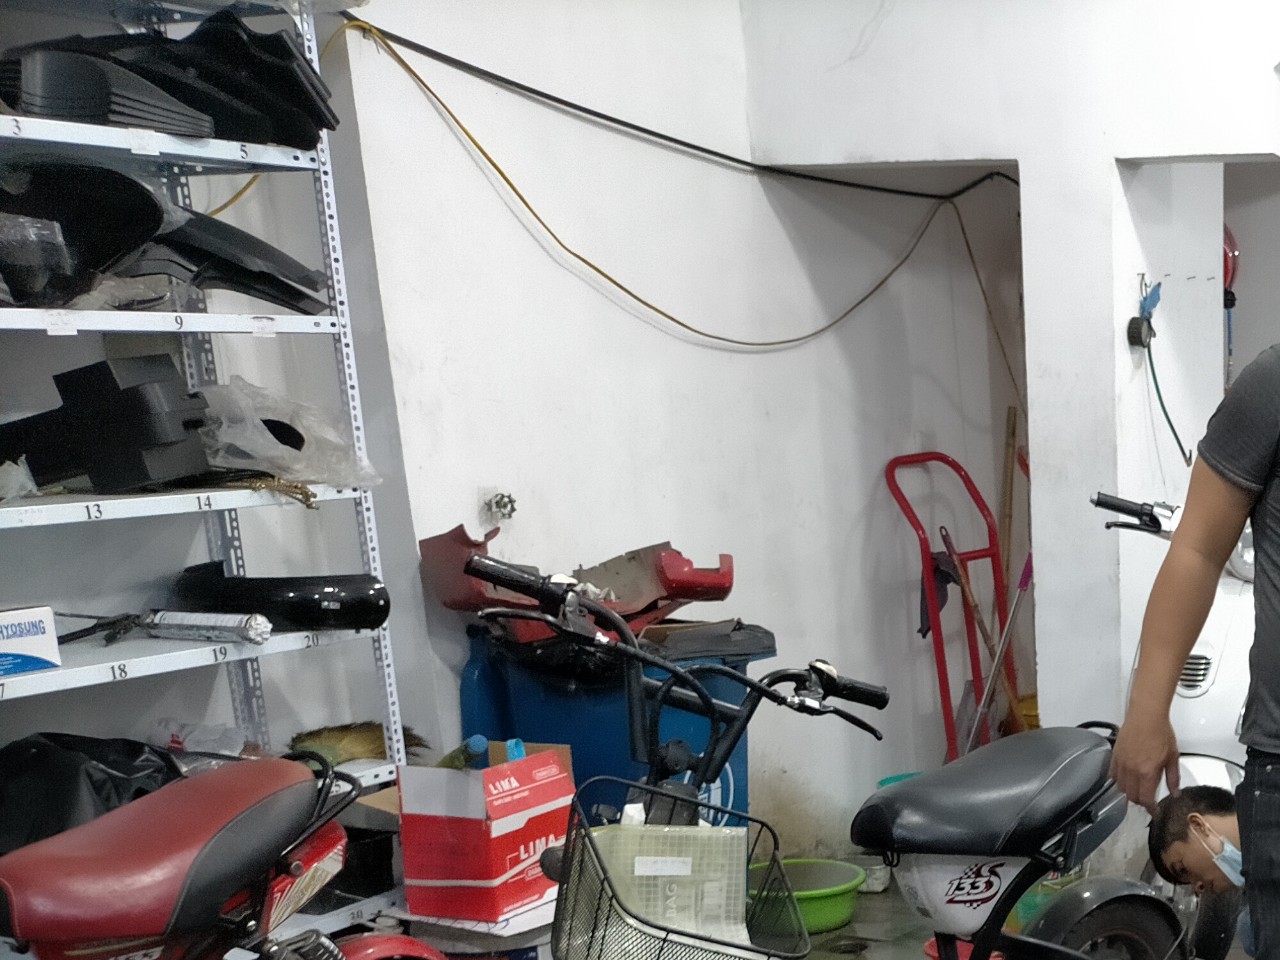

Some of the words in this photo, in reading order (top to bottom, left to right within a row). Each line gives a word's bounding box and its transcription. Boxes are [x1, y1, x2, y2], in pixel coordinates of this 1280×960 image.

[239, 144, 249, 160] 5
[173, 314, 184, 330] 9
[85, 503, 103, 520] 13
[195, 495, 213, 511] 14
[304, 633, 320, 649] 20
[211, 646, 228, 663] 19
[109, 663, 129, 681] 18
[488, 776, 521, 796] LIMA
[519, 833, 556, 861] LIMA
